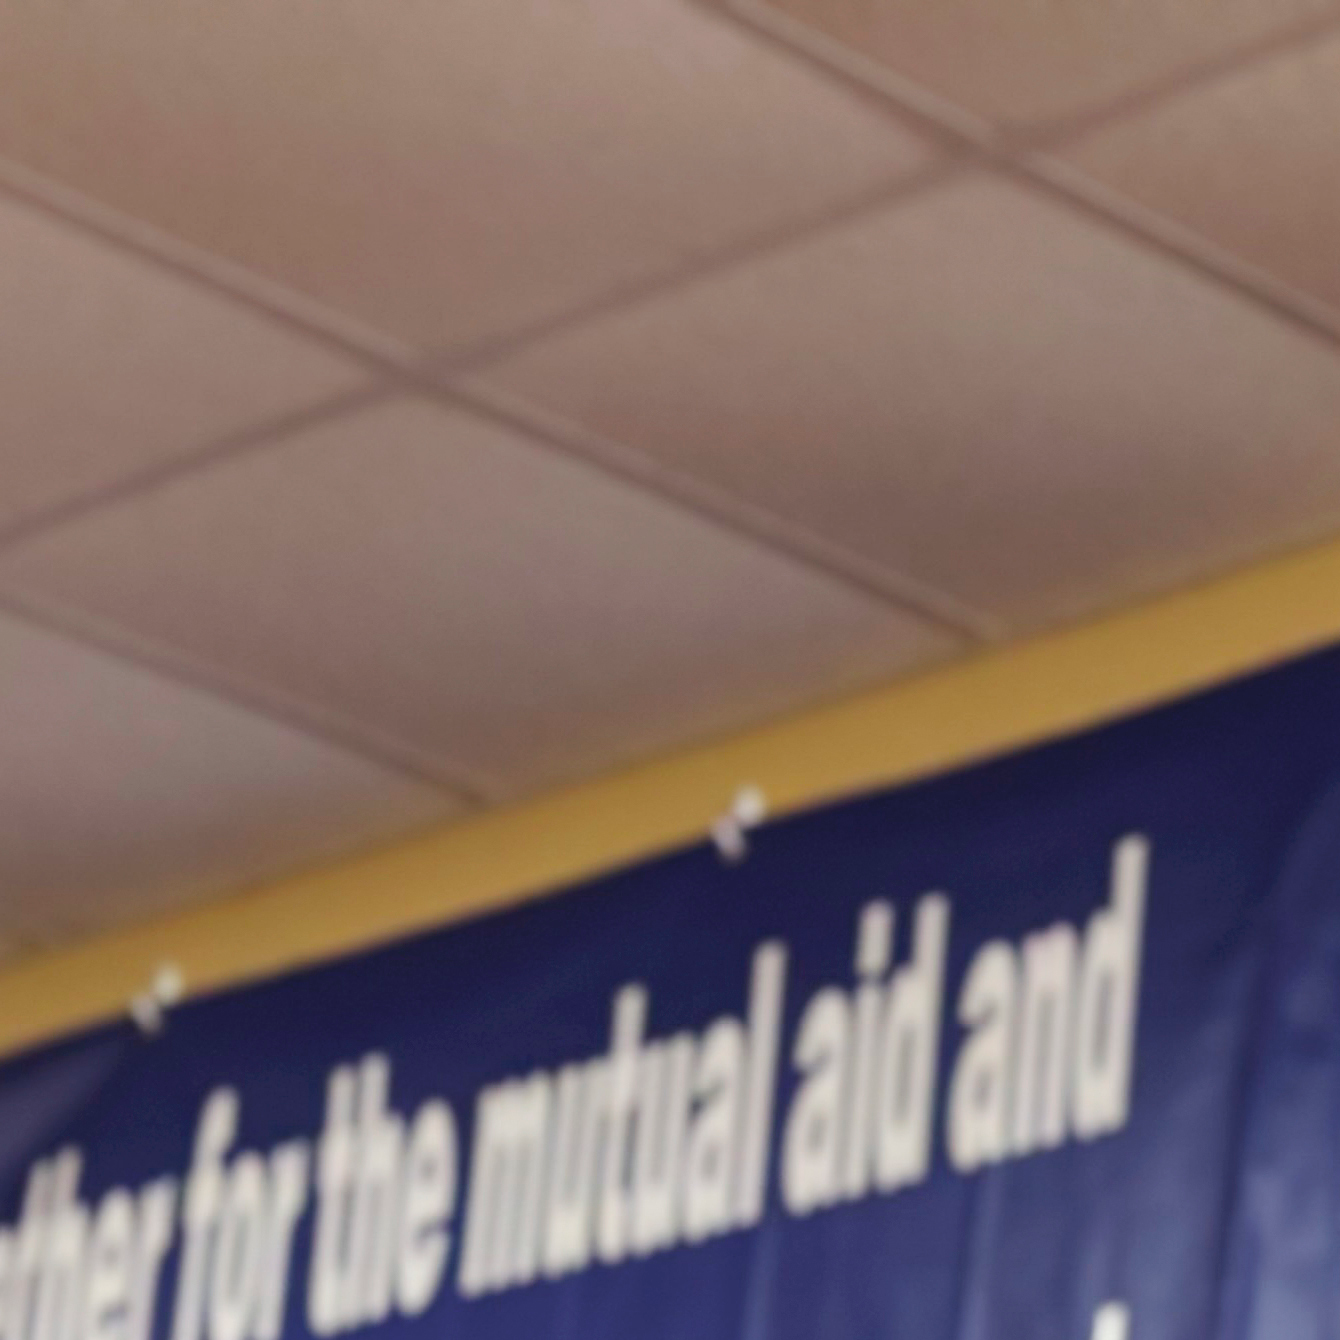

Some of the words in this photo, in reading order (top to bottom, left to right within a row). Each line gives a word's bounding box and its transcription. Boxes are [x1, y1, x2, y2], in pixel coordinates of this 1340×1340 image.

[309, 1052, 456, 1338] the
[457, 941, 786, 1298] mutual
[781, 892, 949, 1217] aid
[946, 833, 1149, 1174] and
